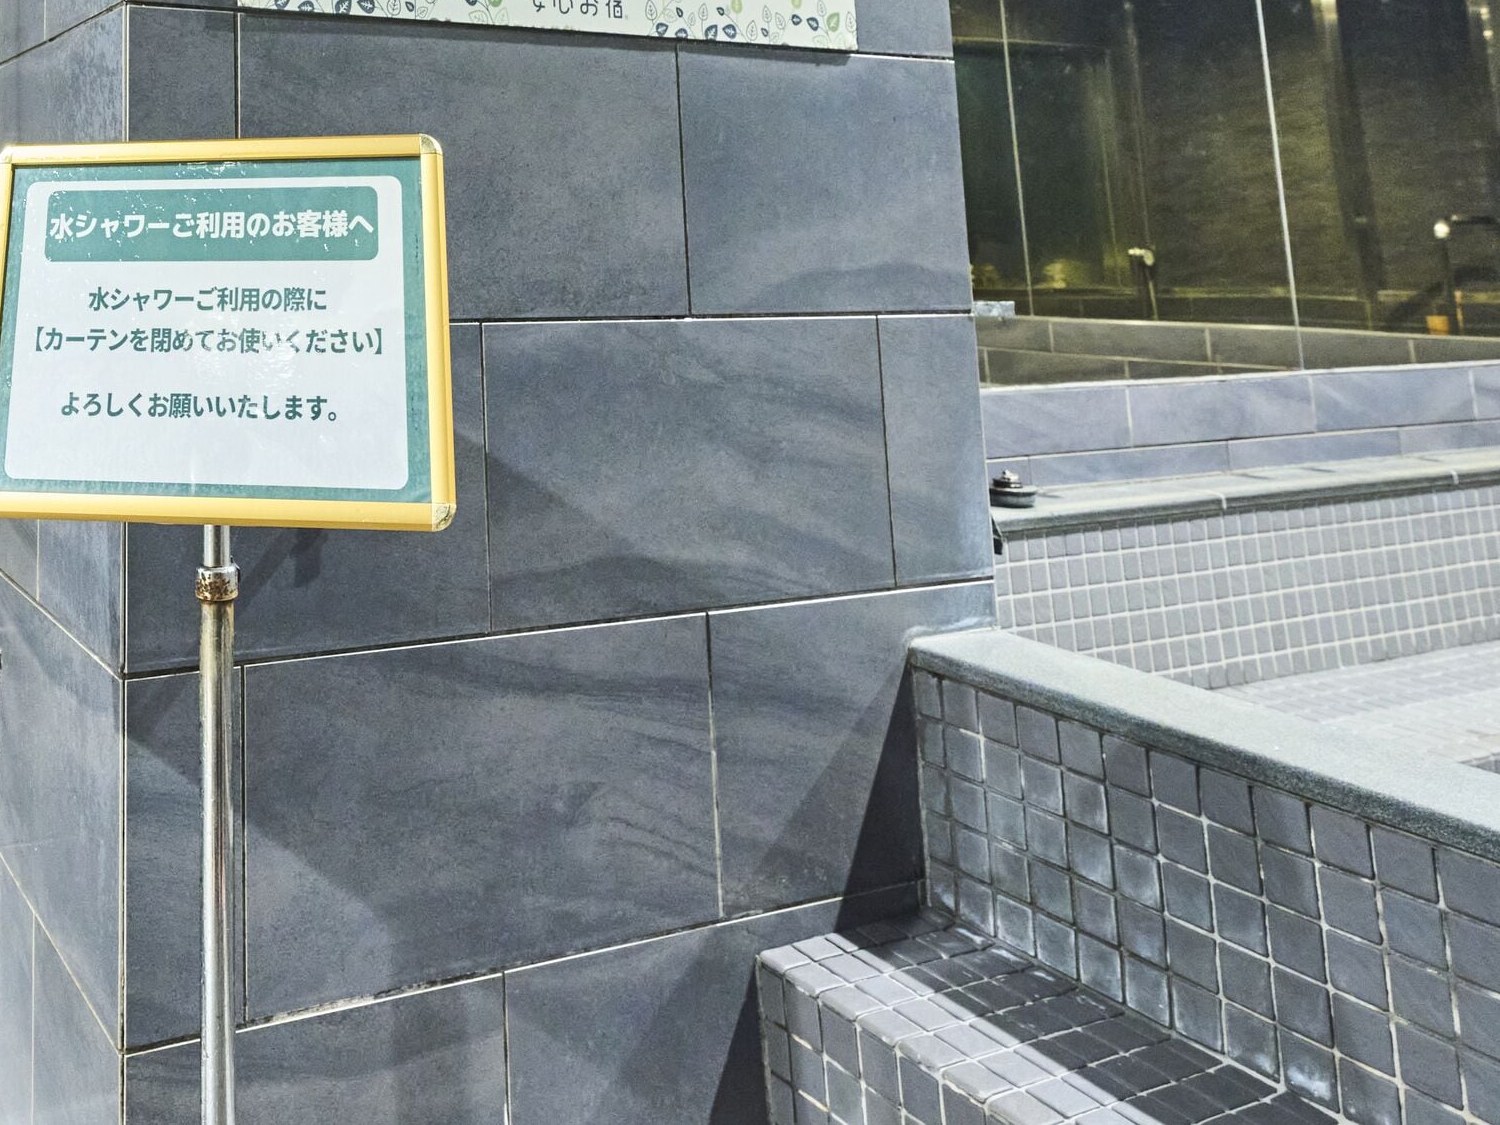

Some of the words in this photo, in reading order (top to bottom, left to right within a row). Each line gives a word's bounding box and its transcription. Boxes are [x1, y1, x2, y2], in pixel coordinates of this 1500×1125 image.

[48, 210, 375, 242] 水シャワーご利用のお客様へ
[87, 286, 328, 313] 水シャワーご利用の際に
[60, 391, 339, 422] よろしくお願いいたします。
